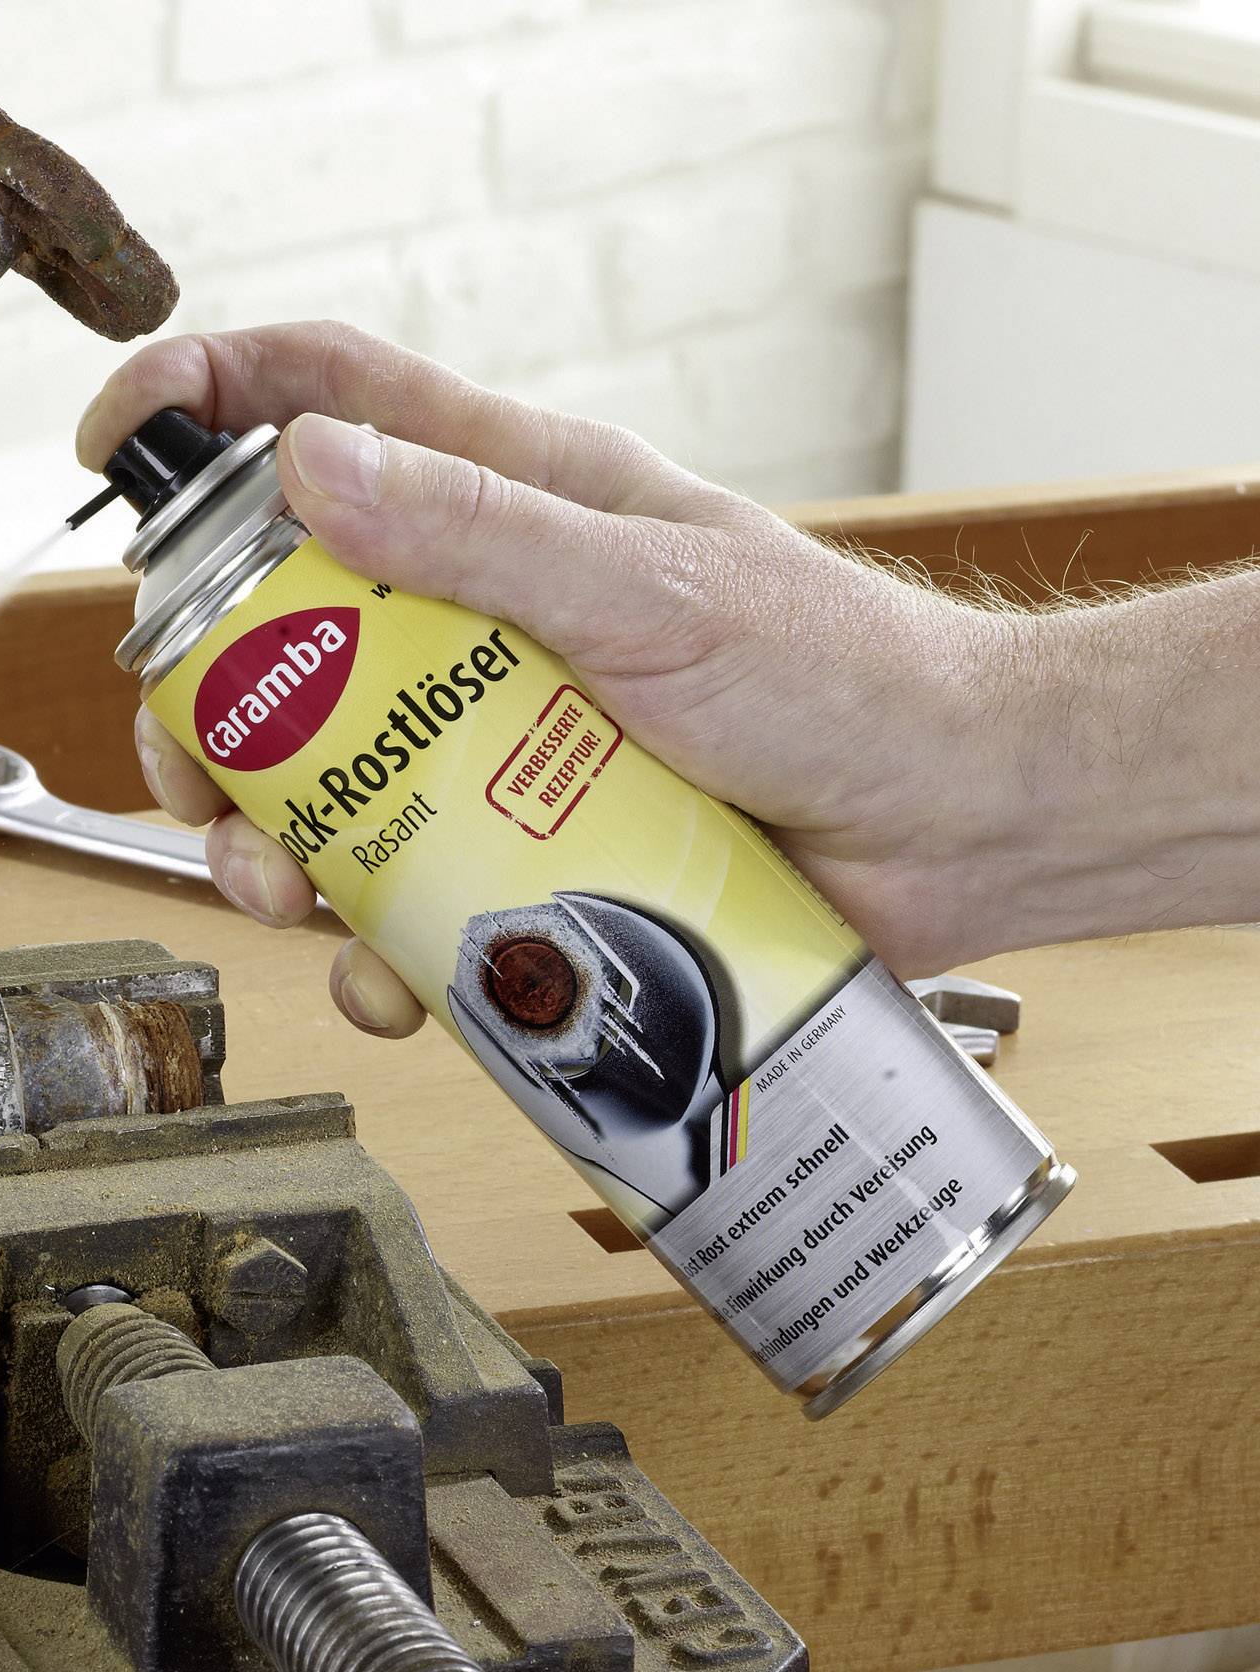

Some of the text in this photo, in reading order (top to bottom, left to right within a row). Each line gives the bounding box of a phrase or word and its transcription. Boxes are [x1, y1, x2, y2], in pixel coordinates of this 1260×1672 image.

[206, 619, 348, 758] caramba
[279, 629, 520, 865] ock-Rostlöser
[506, 702, 584, 798] VERBESSERTE
[538, 730, 602, 808] REZEPTUR!
[351, 792, 438, 874] Rasant
[756, 1005, 847, 1093] MADE IN GERMANY
[695, 1234, 731, 1266] Rost
[729, 1186, 787, 1242] extrem
[785, 1123, 850, 1190] schnell
[726, 1124, 938, 1315] Einwirkung durch Vereisung
[833, 1261, 870, 1299] und
[868, 1176, 964, 1267] Werkzeuge
